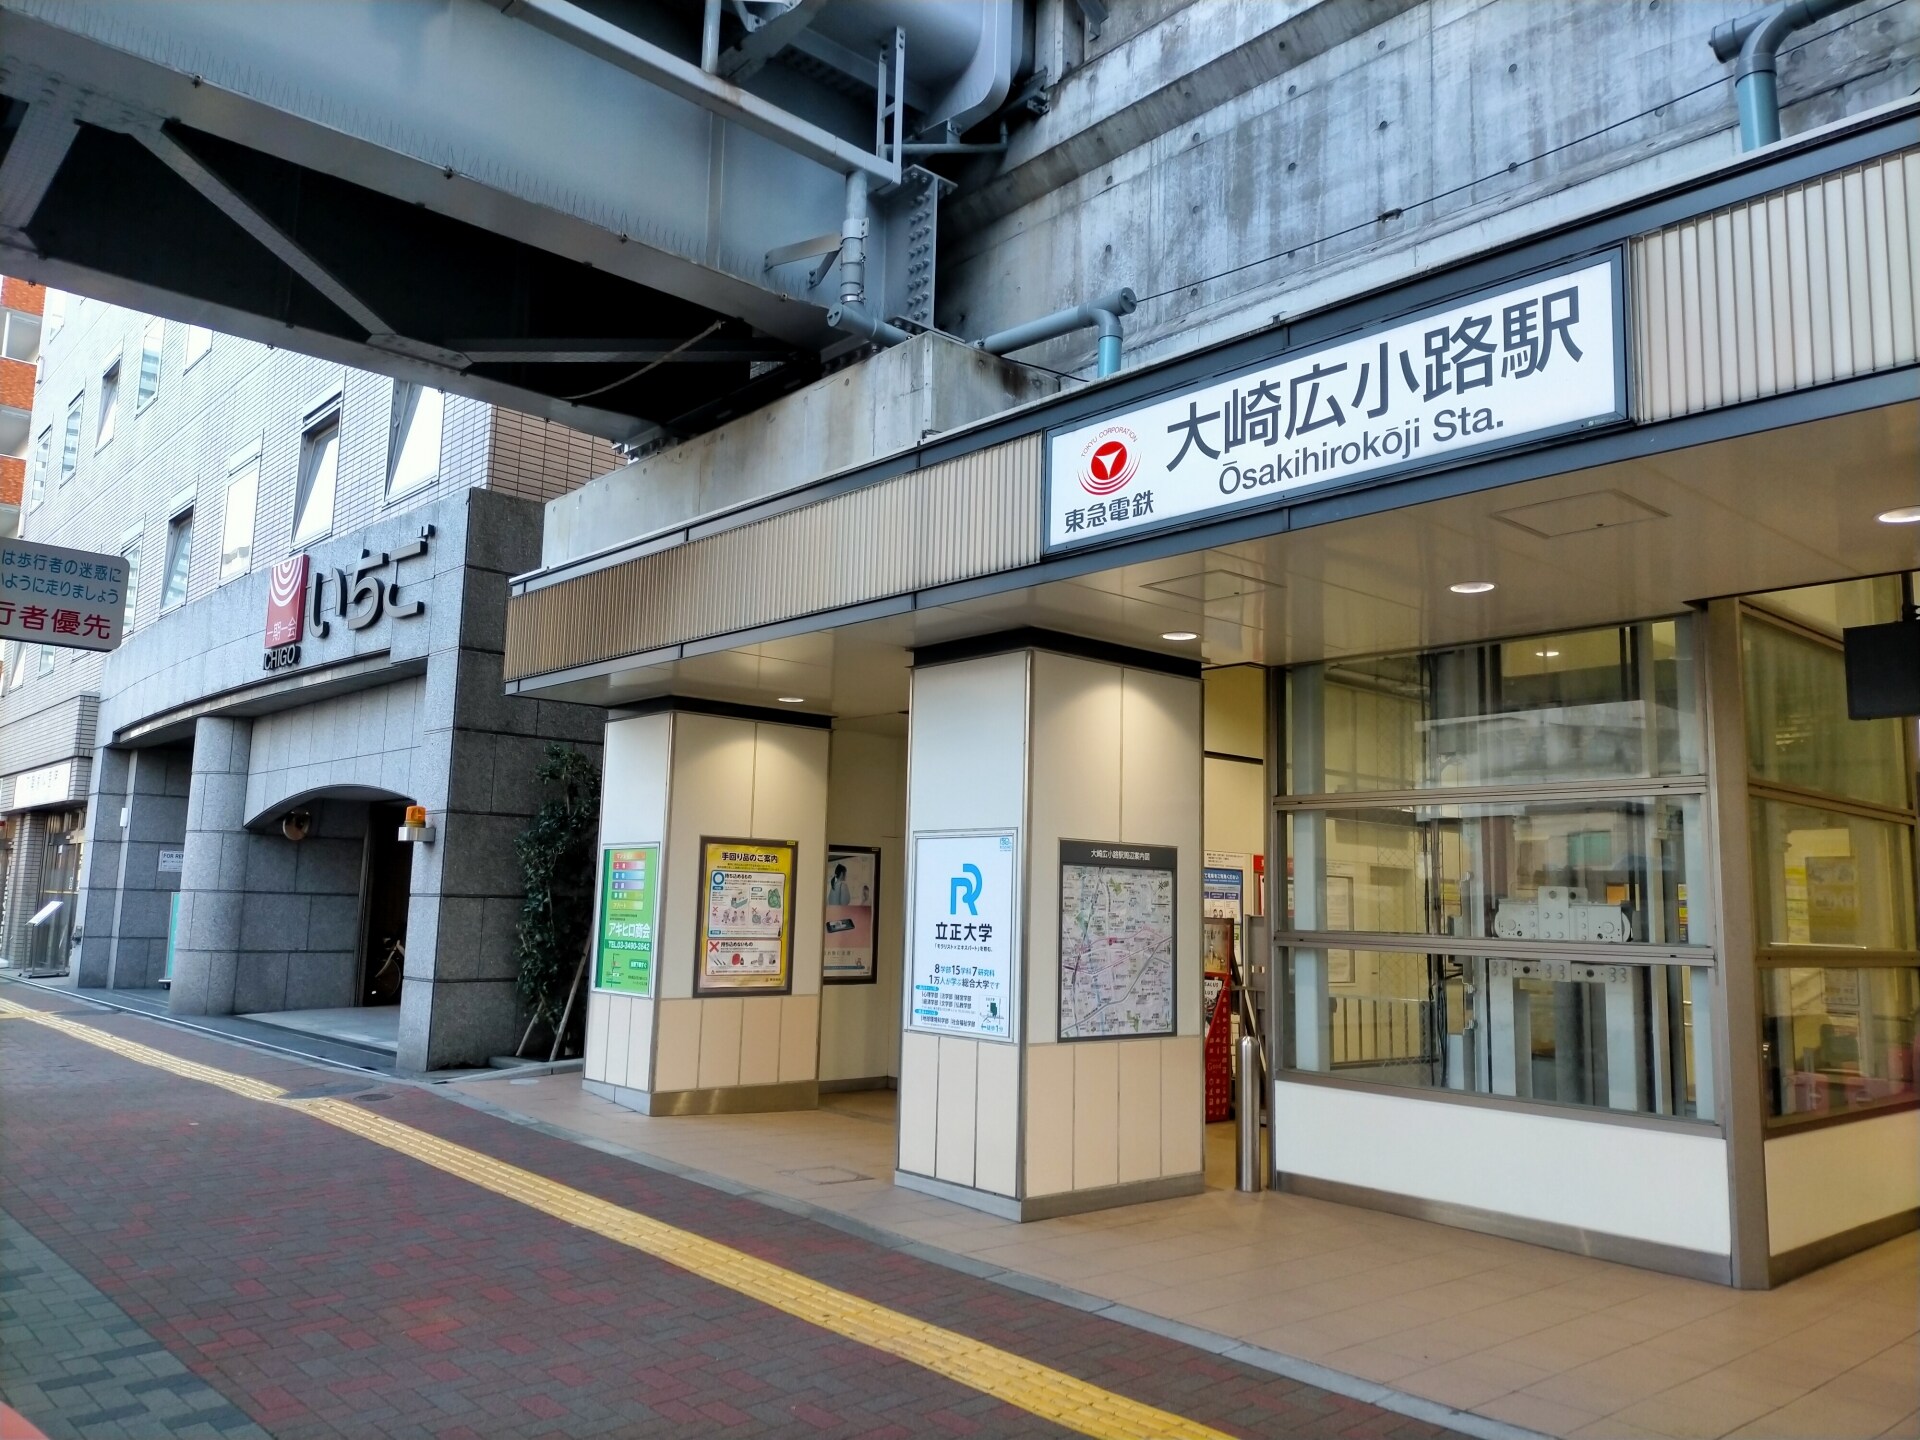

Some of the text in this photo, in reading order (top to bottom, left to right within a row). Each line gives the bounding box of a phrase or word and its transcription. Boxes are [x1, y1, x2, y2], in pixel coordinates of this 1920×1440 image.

[1166, 285, 1584, 472] 大崎広小路駅
[1081, 426, 1138, 458] TOKYU CORPORATION
[1218, 406, 1504, 495] Ōsakihirokōji Sta.
[1064, 489, 1154, 534] 東急電鉄
[308, 523, 436, 639] いちご
[935, 921, 993, 943] 立正大学
